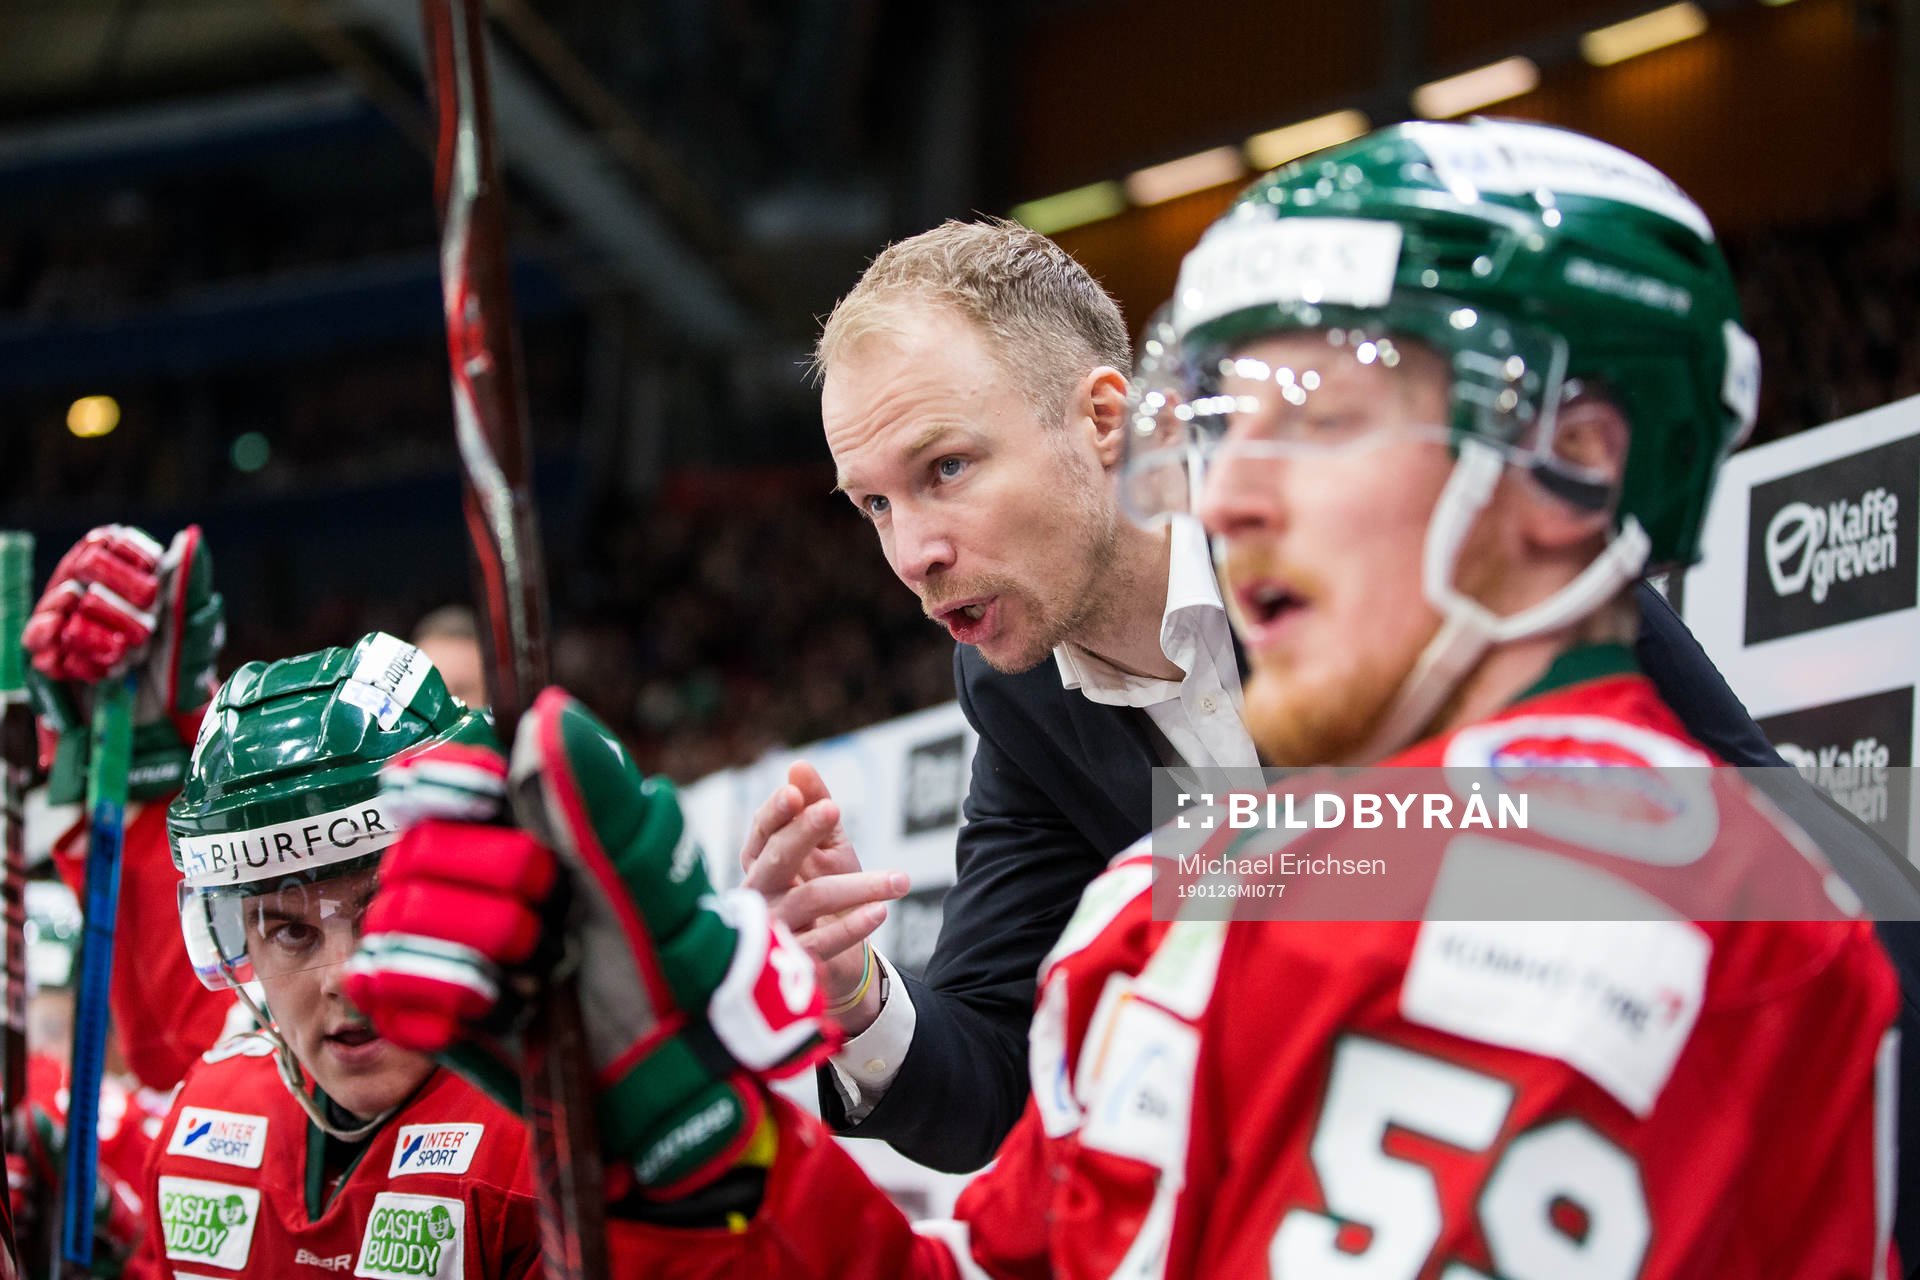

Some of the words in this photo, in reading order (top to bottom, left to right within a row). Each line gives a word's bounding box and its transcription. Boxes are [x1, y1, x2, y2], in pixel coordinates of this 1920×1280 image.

[1828, 487, 1898, 545] Kaffe
[1811, 531, 1897, 603] greven
[1818, 737, 1889, 788] Kaffe
[211, 808, 391, 880] BJURFOR
[213, 1120, 256, 1140] INTER
[423, 1132, 464, 1148] INTER
[207, 1138, 249, 1158] SPORT
[416, 1149, 457, 1167] SPORT
[1268, 1034, 1652, 1280] 59
[165, 1220, 228, 1256] UDDY
[373, 1211, 422, 1242] CASH
[366, 1240, 438, 1274] BUDDY
